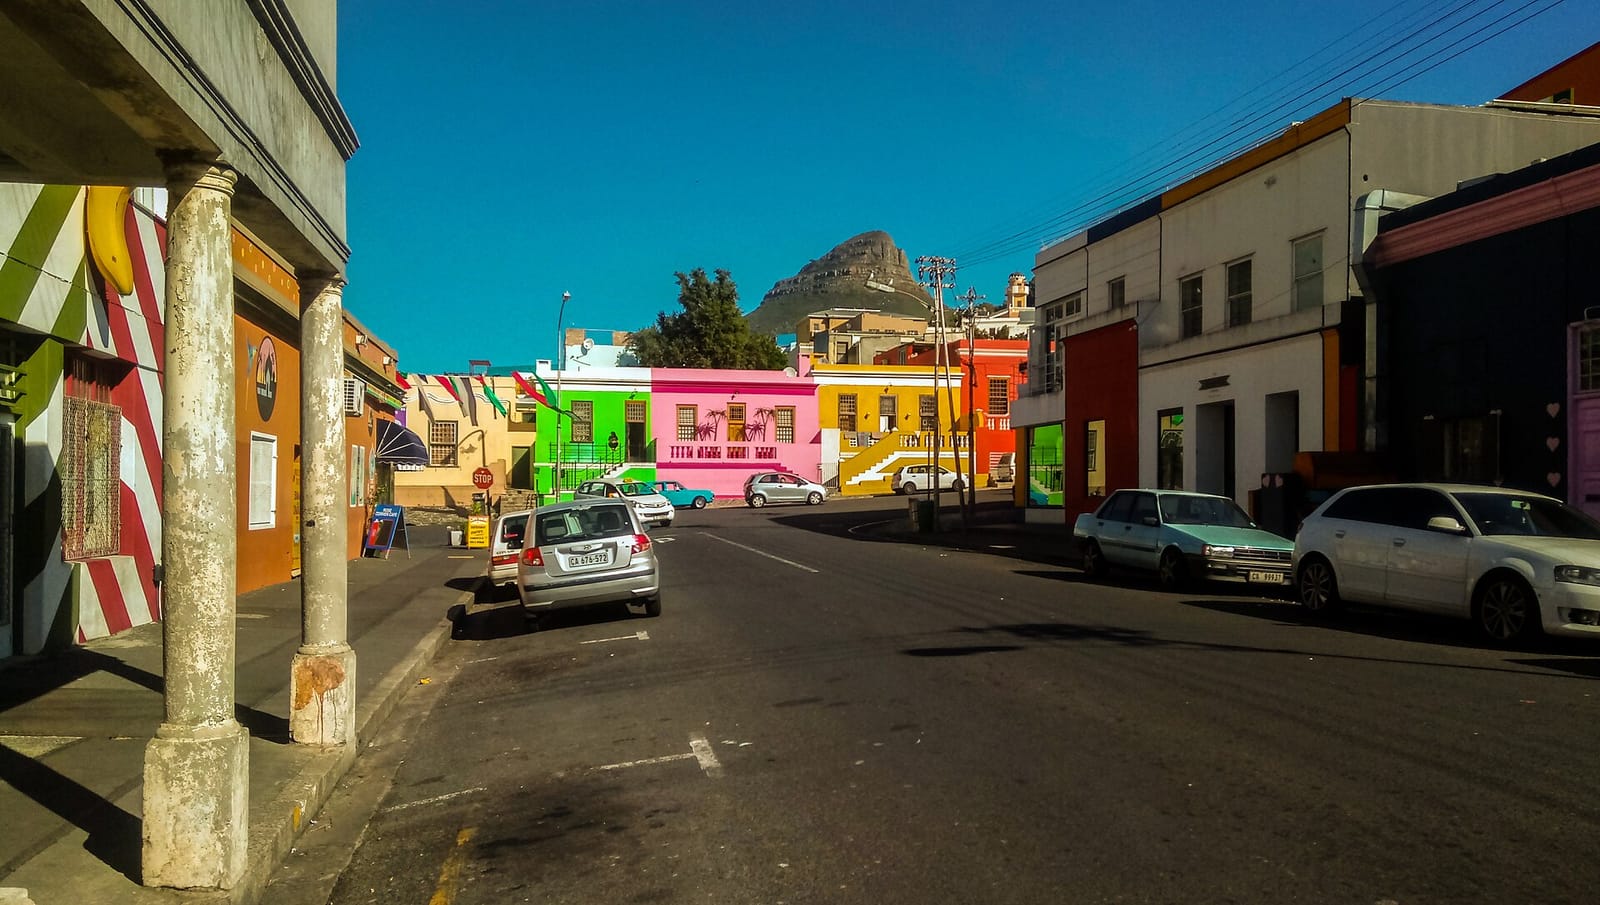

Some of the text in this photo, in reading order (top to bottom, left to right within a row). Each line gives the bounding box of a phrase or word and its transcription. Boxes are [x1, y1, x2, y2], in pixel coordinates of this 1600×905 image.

[474, 474, 492, 484] STOP
[571, 554, 607, 565] CA 676-572
